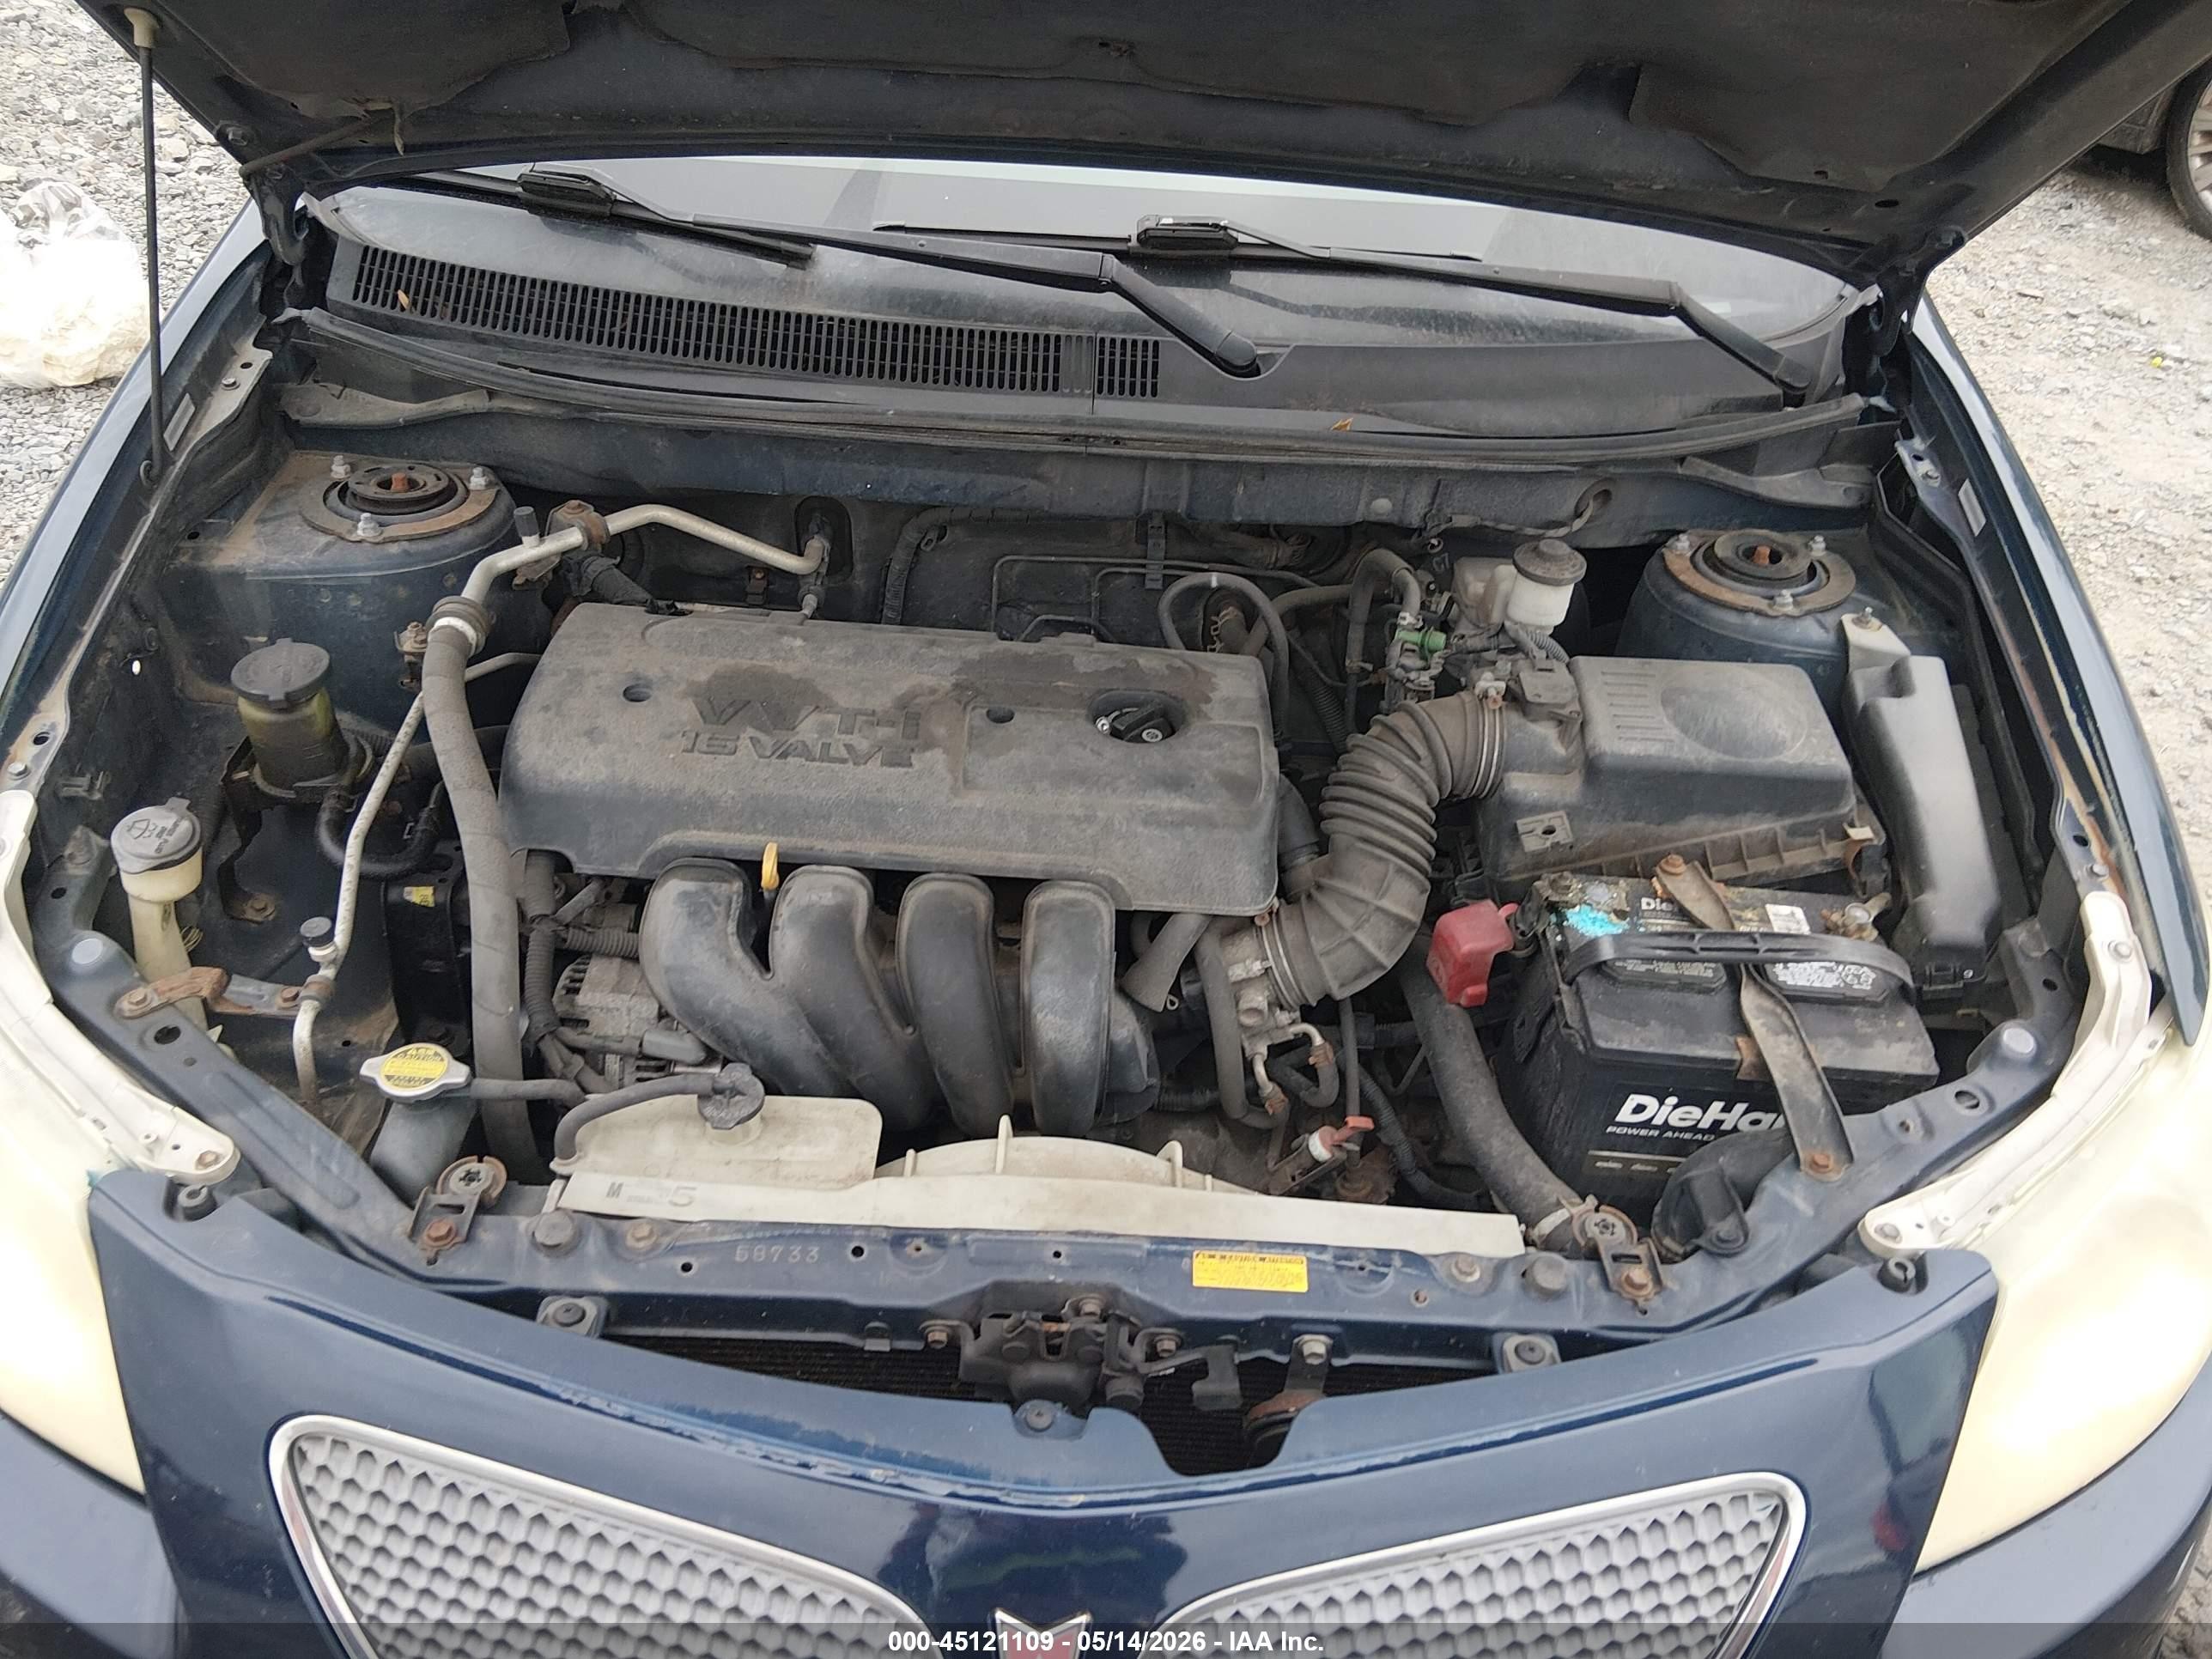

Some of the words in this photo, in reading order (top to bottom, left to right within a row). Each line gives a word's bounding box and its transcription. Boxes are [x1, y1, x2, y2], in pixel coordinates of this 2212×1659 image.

[747, 733, 914, 768] VALVE
[1605, 1125, 1659, 1138] POWER
[1662, 1130, 1716, 1142] AHEAD
[605, 1182, 624, 1200] M
